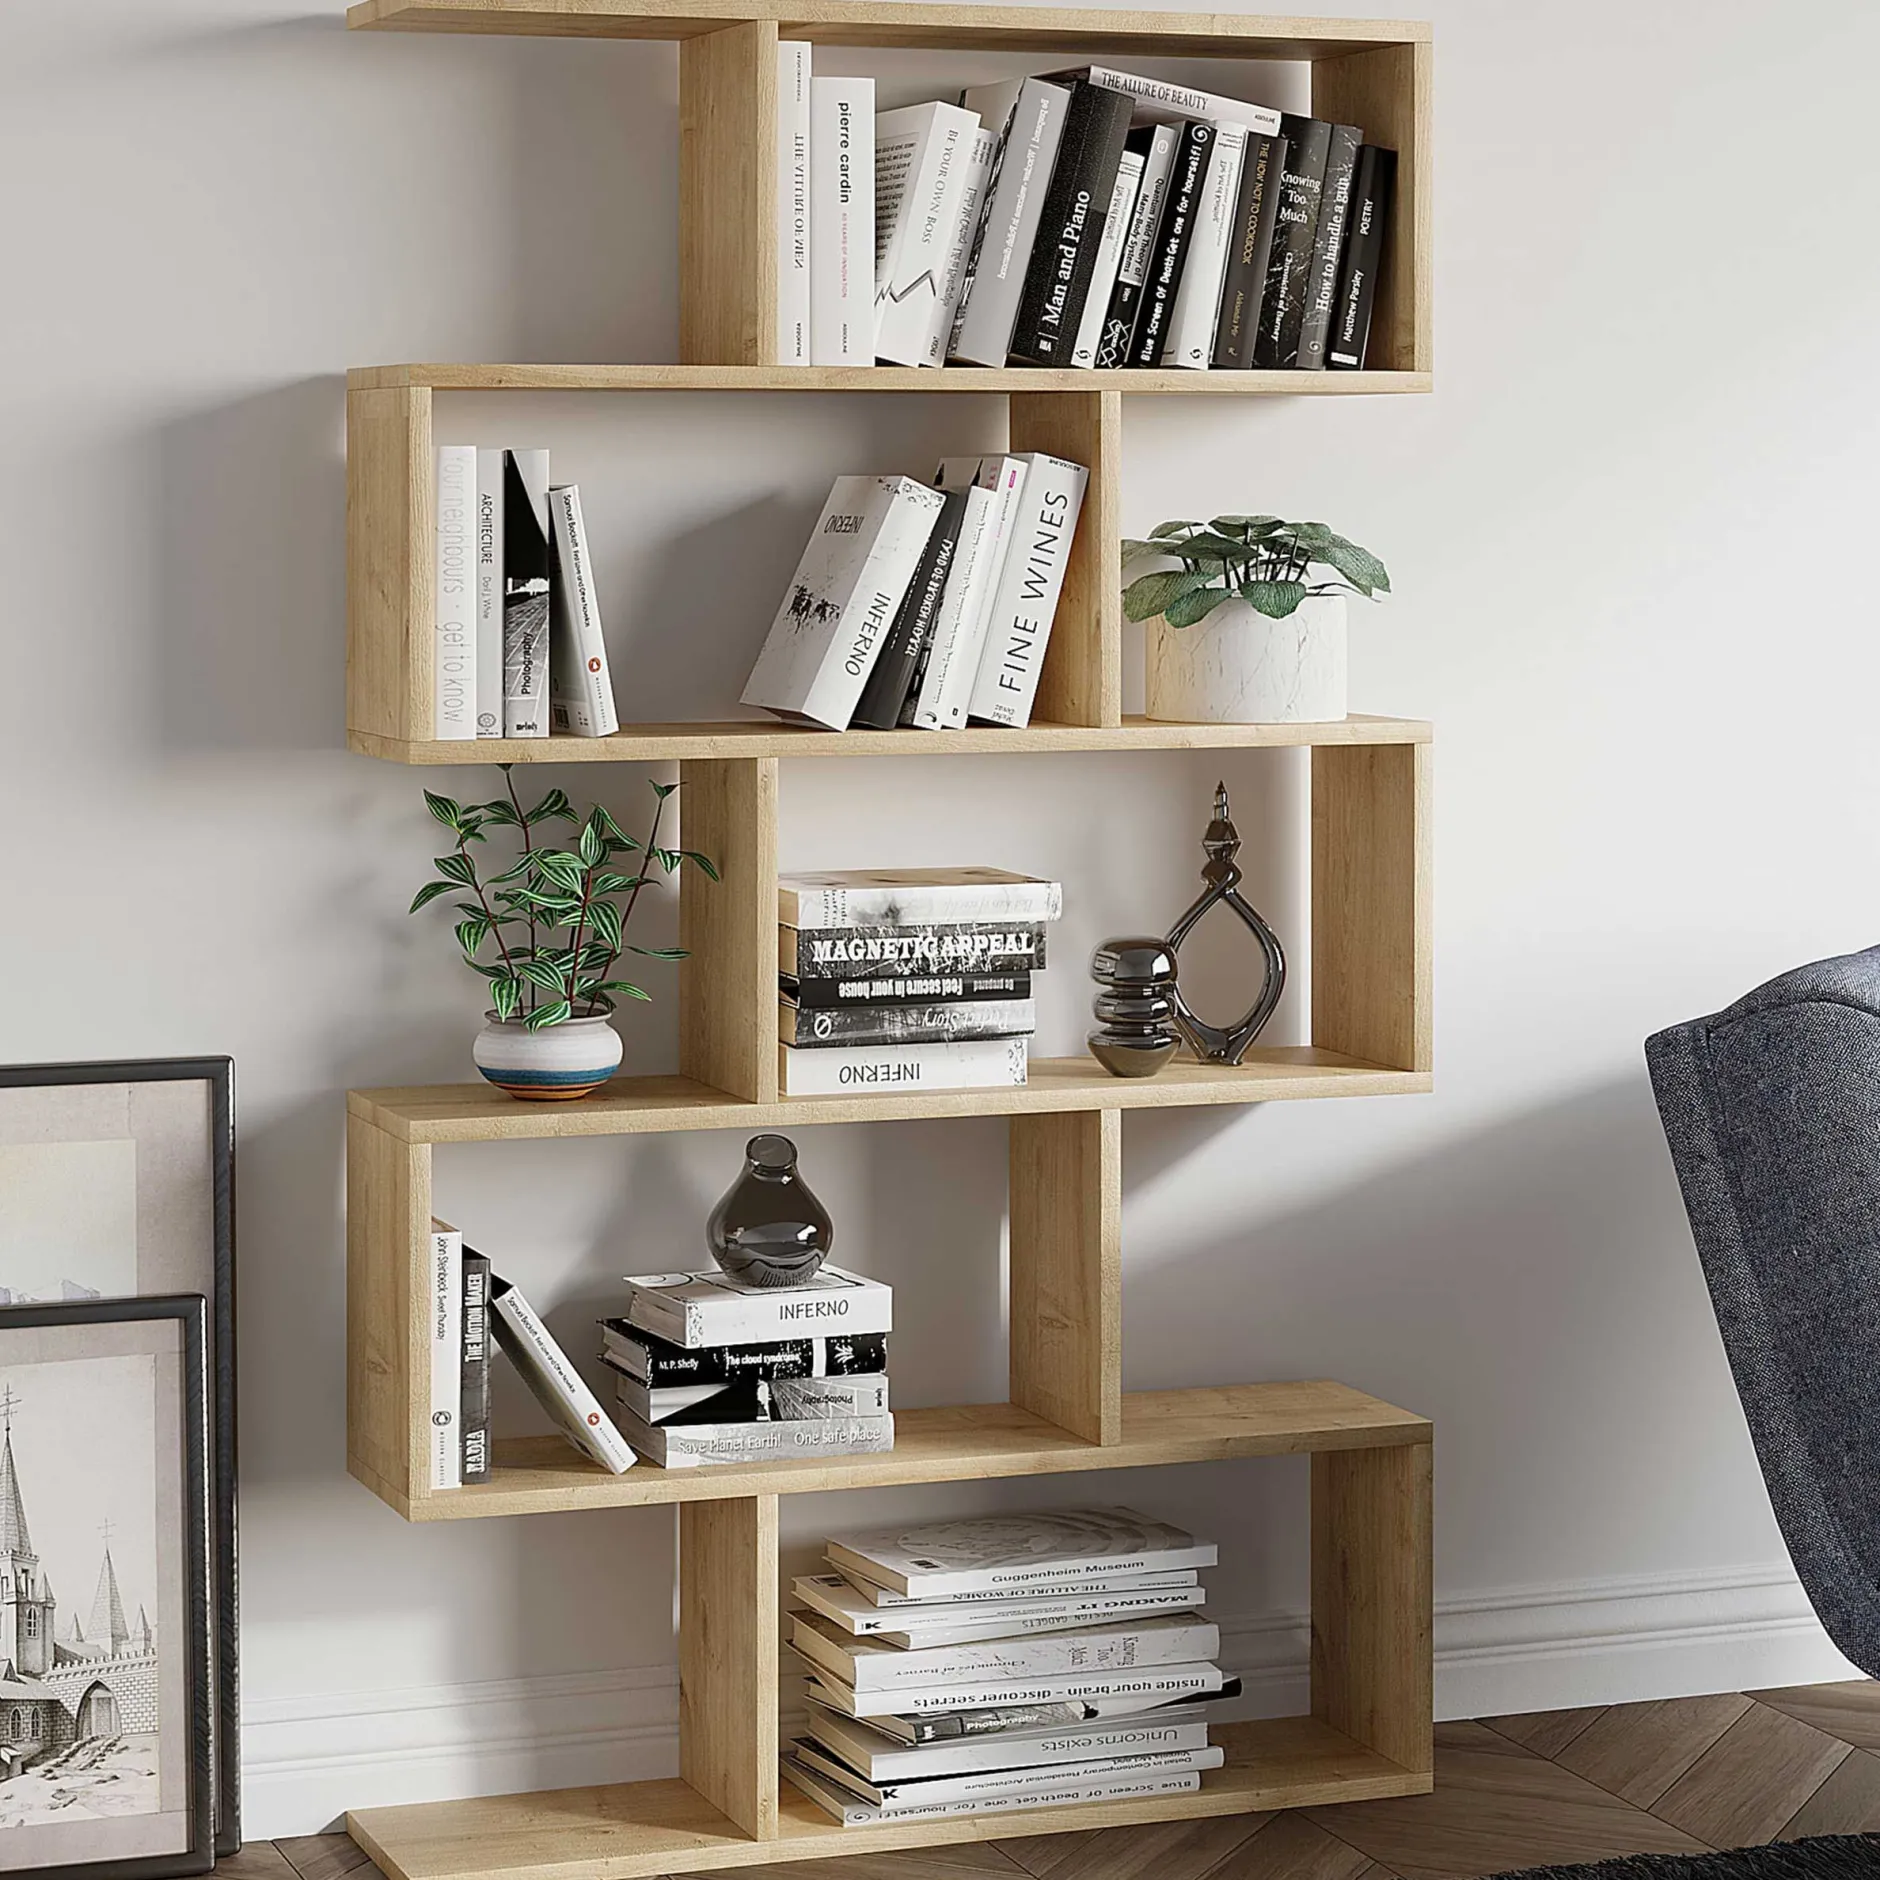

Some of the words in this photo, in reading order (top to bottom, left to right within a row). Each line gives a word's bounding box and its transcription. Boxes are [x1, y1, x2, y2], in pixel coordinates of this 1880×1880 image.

[1098, 71, 1121, 88] THE
[1119, 76, 1159, 98] ALLURE
[1156, 85, 1171, 101] OF
[1170, 89, 1208, 110] BEAUTY
[837, 101, 850, 148] pierre
[945, 128, 958, 143] BE
[1258, 142, 1269, 157] THE
[937, 145, 954, 178] YOUR
[1254, 158, 1267, 180] HOW
[839, 153, 851, 203] cardin
[928, 179, 946, 212] OWN
[1147, 176, 1165, 216] Quantum
[1251, 181, 1263, 201] NOT
[1286, 189, 1307, 205] Too
[1334, 176, 1351, 204] gun
[1175, 194, 1190, 214] for
[1249, 200, 1260, 214] TO
[1333, 203, 1345, 214] a
[1061, 188, 1092, 243] Piano
[1130, 192, 1149, 239] Many-Body
[1279, 206, 1309, 223] Much
[1359, 197, 1374, 235] POETRY
[920, 215, 937, 245] BOSS
[1143, 216, 1155, 237] Field
[1171, 215, 1185, 235] one
[1165, 236, 1180, 256] Get
[1240, 214, 1258, 265] COOKBOOK
[1321, 213, 1343, 262] handle
[1121, 239, 1138, 274] Systems
[1134, 237, 1149, 266] Theory
[1050, 243, 1077, 280] and
[1158, 254, 1176, 284] Death
[1320, 261, 1335, 278] to
[1133, 266, 1143, 277] of
[1154, 285, 1168, 299] Of
[1348, 268, 1365, 301] Parsley
[1040, 281, 1068, 326] Man
[1315, 278, 1333, 311] How
[1146, 300, 1165, 335] Screen
[1341, 300, 1358, 342] Matthew
[1140, 336, 1156, 362] Blue
[481, 493, 492, 564] ARCHITECTURE
[998, 614, 1038, 692] FINE
[1021, 490, 1069, 601] WINES
[844, 591, 892, 677] INFERNO
[520, 631, 533, 694] Photography
[837, 980, 869, 999] house
[870, 978, 893, 996] your
[893, 979, 905, 997] in
[905, 977, 941, 995] secure
[940, 977, 962, 996] Feel
[920, 1006, 960, 1033] Story
[837, 1062, 920, 1084] INFERNO
[464, 1272, 482, 1306] MAKER
[778, 1298, 849, 1320] INFERNO
[464, 1307, 482, 1343] MOTION
[464, 1344, 482, 1362] THE
[741, 1353, 762, 1364] cloud
[800, 1393, 853, 1407] Photography
[678, 1439, 707, 1456] Save
[709, 1436, 745, 1453] Planet
[746, 1431, 783, 1450] Earth!
[793, 1429, 820, 1446] One
[821, 1427, 847, 1444] safe
[848, 1424, 882, 1445] place
[991, 1566, 1081, 1583] Guggenheim
[1084, 1560, 1144, 1573] Museum
[951, 1590, 1004, 1600] WOMEN
[1006, 1588, 1024, 1596] OF
[1027, 1585, 1079, 1595] ALLURE
[1081, 1583, 1108, 1592] THE
[1066, 1685, 1110, 1697] brain
[1111, 1681, 1152, 1692] your
[1155, 1678, 1205, 1690] Inside
[912, 1695, 976, 1708] secrets
[979, 1689, 1051, 1703] discover
[966, 1713, 1039, 1731] Photography
[1040, 1737, 1093, 1752] exists
[1095, 1729, 1178, 1747] Unicorns
[1082, 1761, 1151, 1774] Contemporary
[1163, 1756, 1192, 1764] Detail
[964, 1778, 1024, 1789] Architecture
[1025, 1771, 1080, 1781] Residential
[1160, 1780, 1191, 1789] Blue
[881, 1788, 899, 1799] K
[1040, 1791, 1079, 1802] Death
[1084, 1789, 1102, 1798] Of
[1108, 1783, 1154, 1795] Screen
[952, 1802, 976, 1811] for
[983, 1799, 1008, 1807] one
[1014, 1796, 1037, 1805] Get
